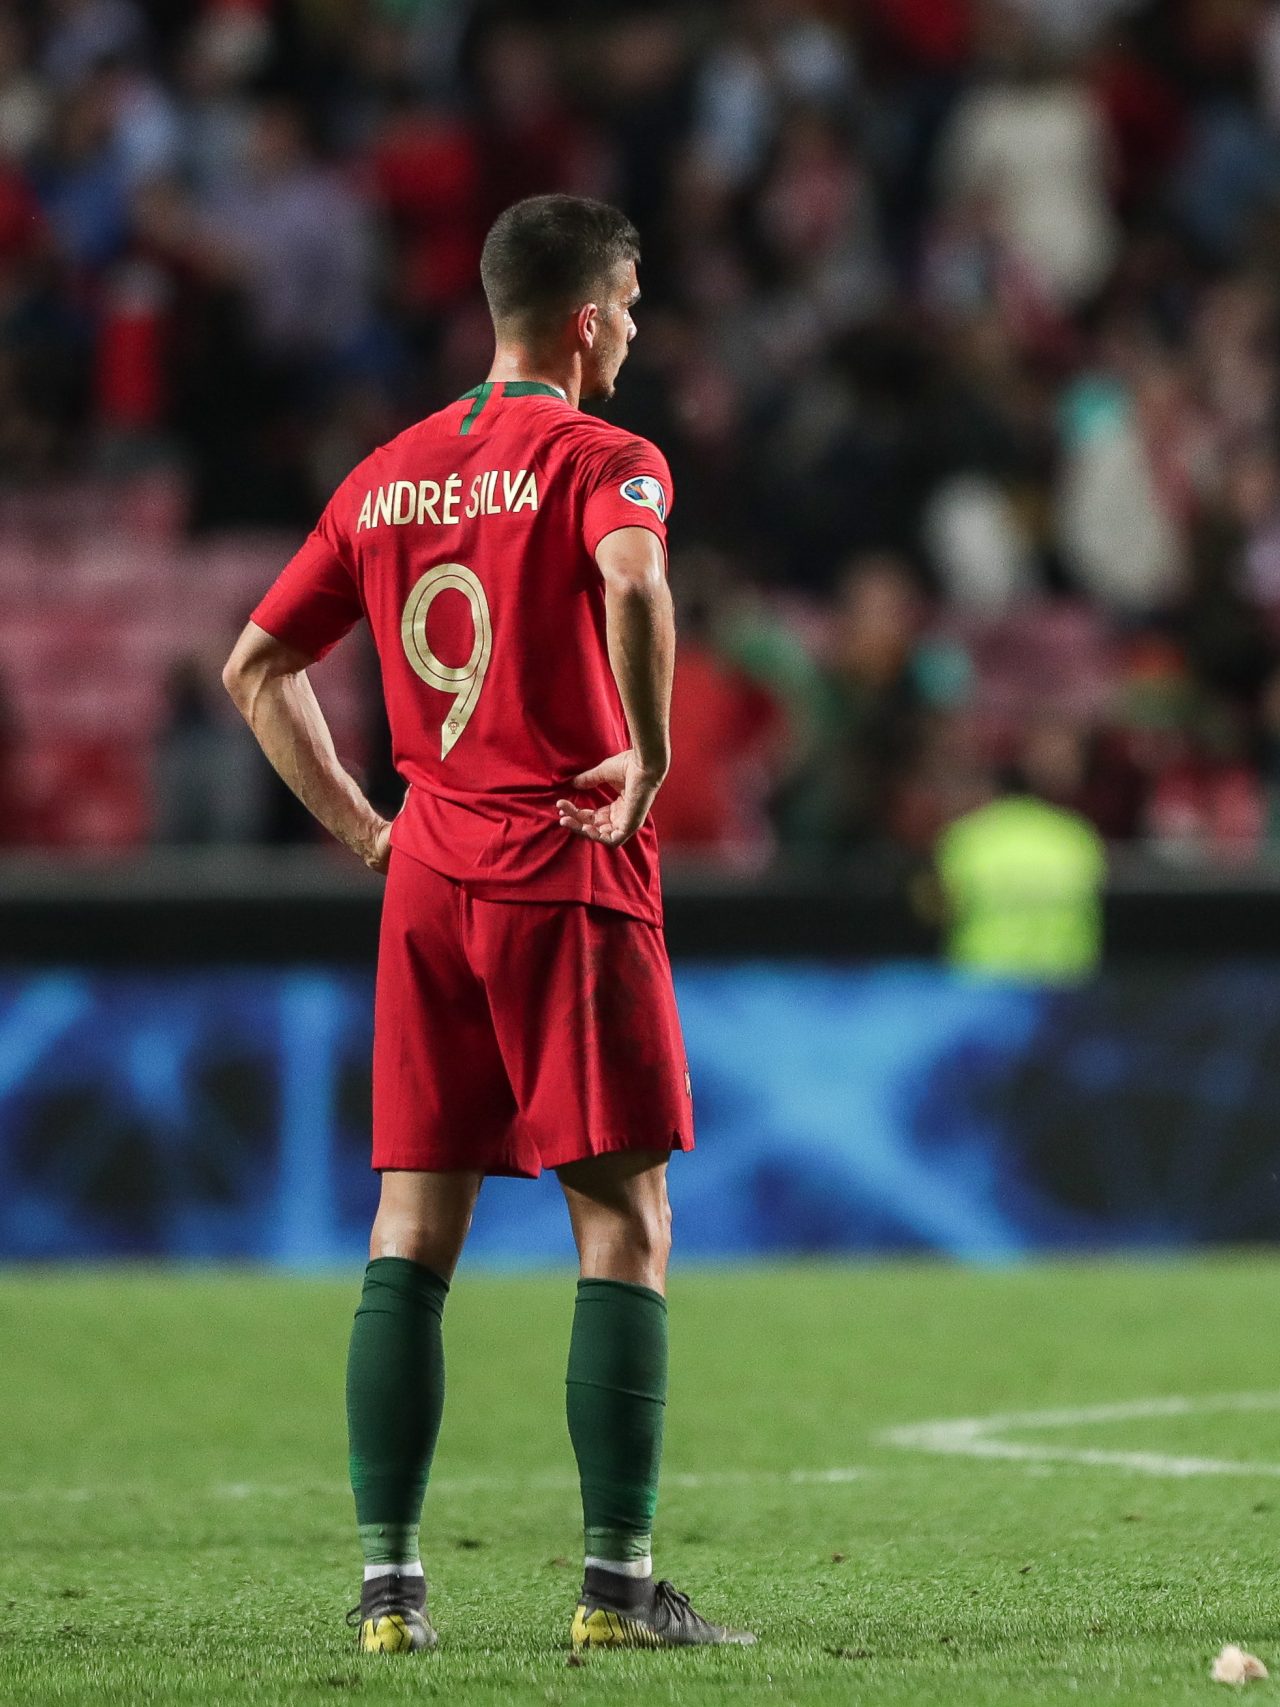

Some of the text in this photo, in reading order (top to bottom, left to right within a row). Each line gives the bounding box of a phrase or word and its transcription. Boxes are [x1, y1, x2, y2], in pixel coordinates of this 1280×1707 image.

[357, 470, 538, 532] ANDRÉ SILVA
[401, 563, 492, 761] 9
